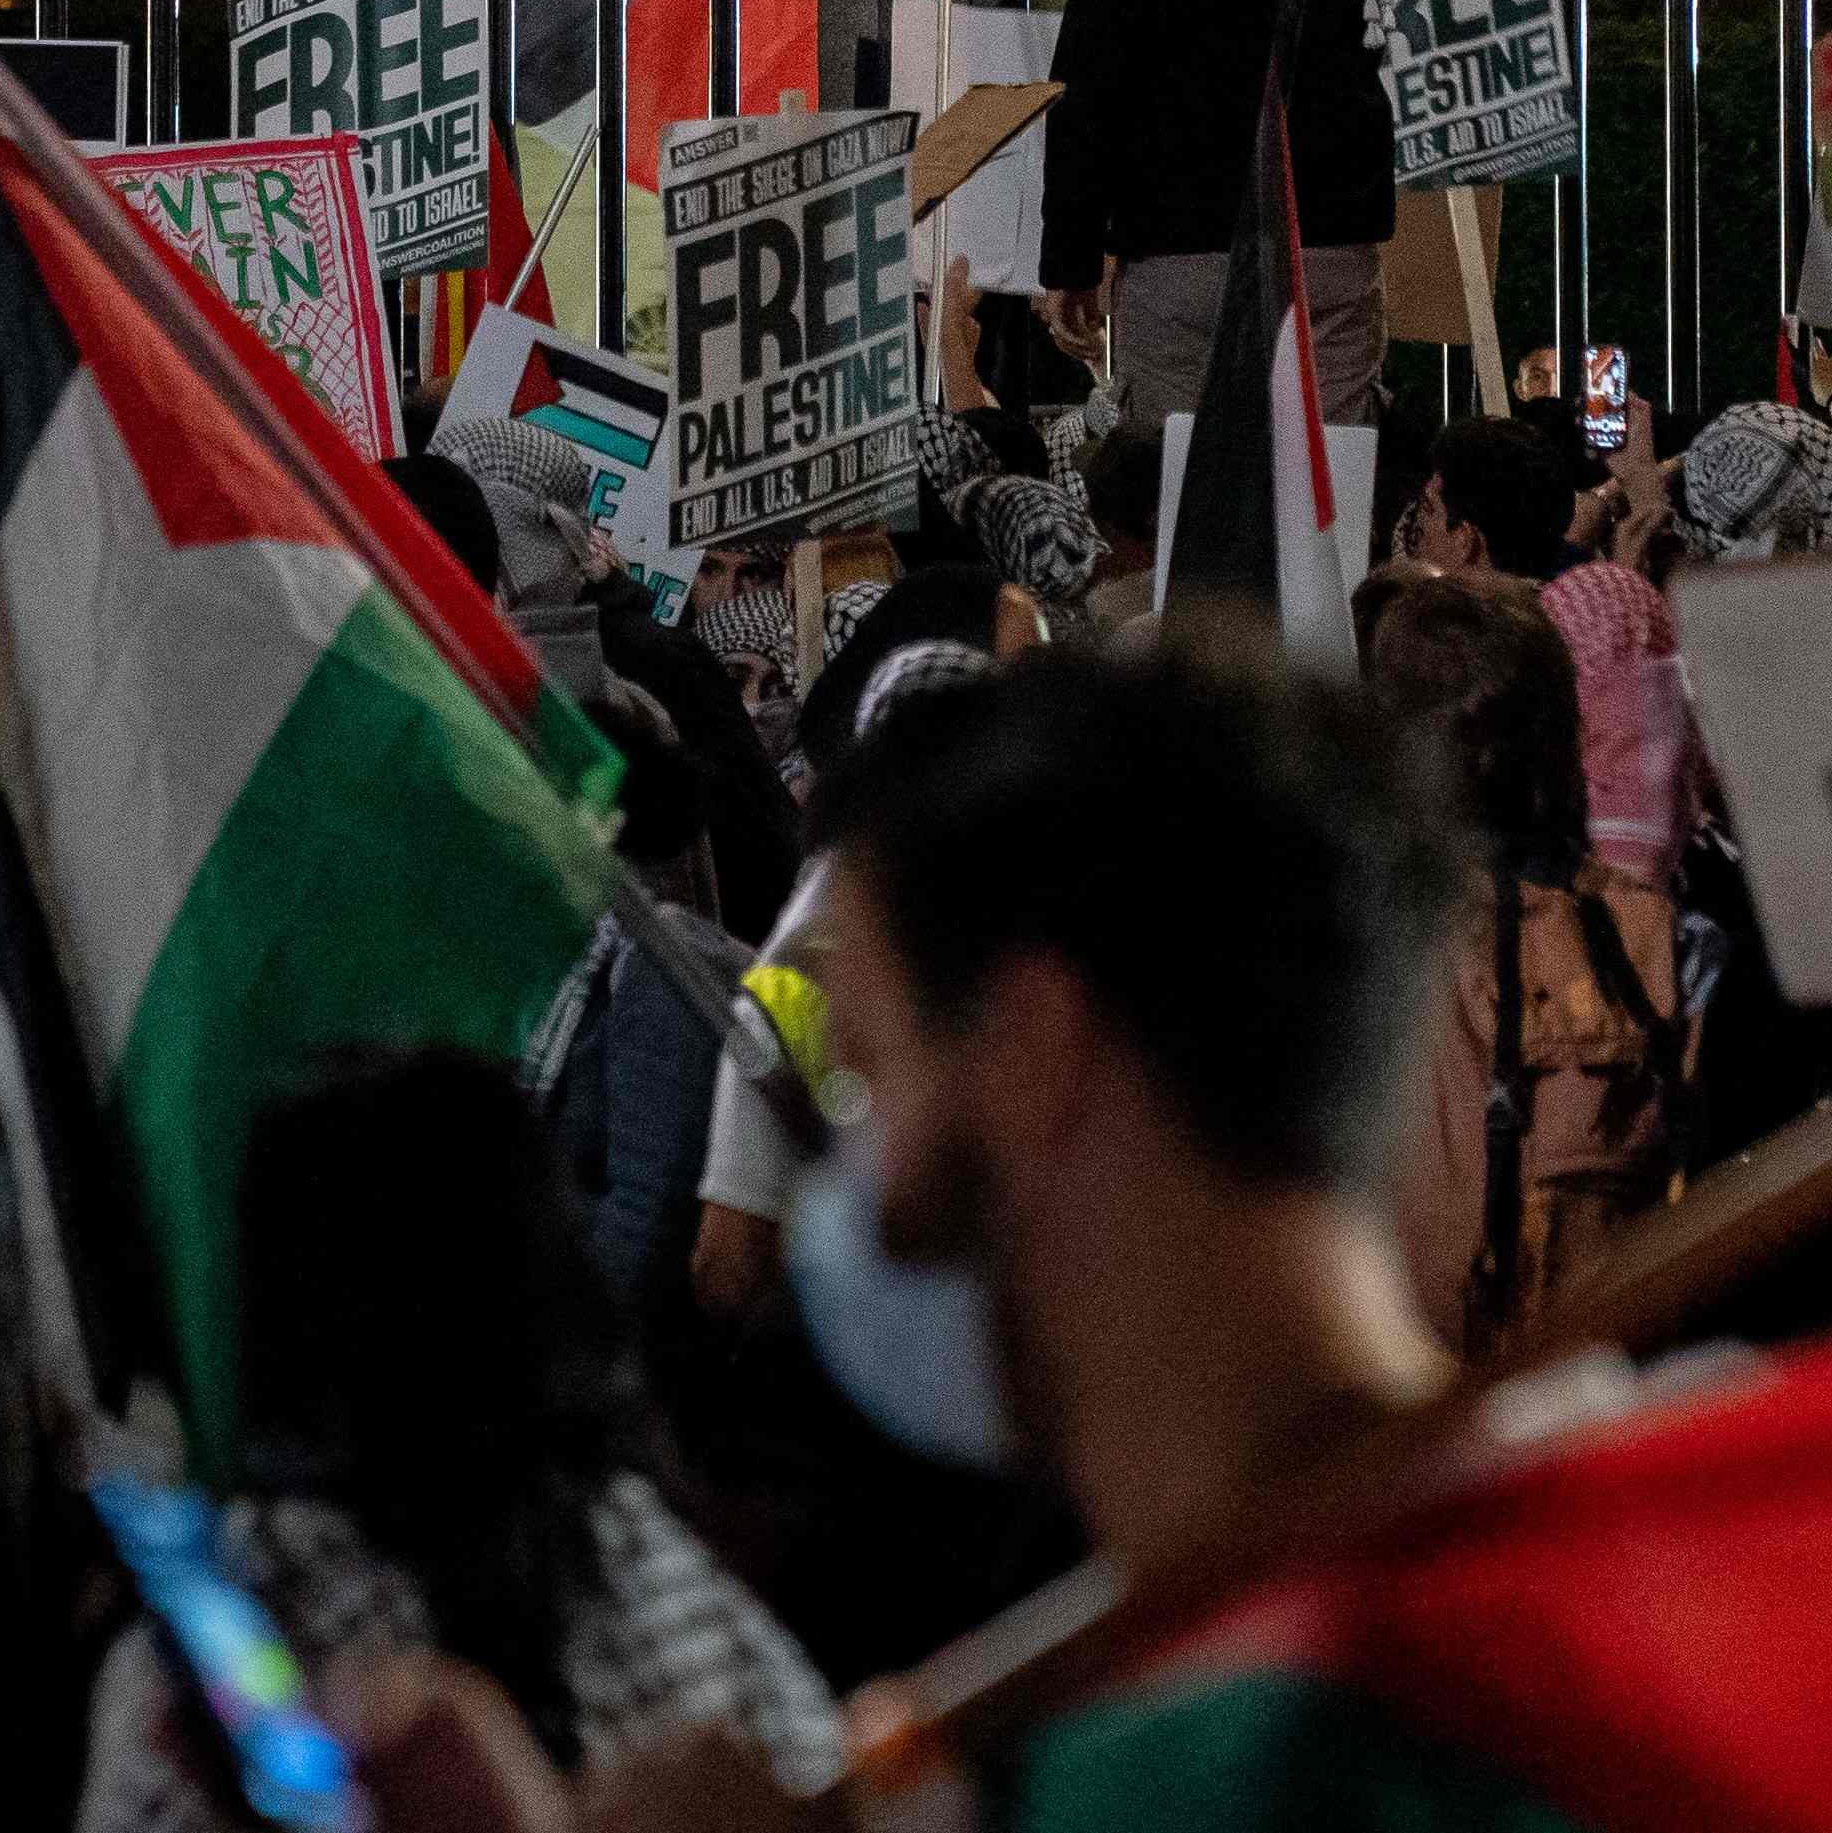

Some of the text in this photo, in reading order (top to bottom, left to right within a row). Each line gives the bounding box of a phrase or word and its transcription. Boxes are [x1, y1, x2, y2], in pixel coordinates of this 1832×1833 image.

[674, 129, 736, 166] ANSWER
[674, 117, 912, 231] END THE SIEGE ON GAZA NOW!
[395, 199, 418, 236] TO
[424, 179, 484, 227] ISRAEL
[676, 167, 907, 405] FREE
[681, 494, 717, 541] END
[723, 481, 757, 528] ALL
[763, 468, 803, 514] U.S.
[809, 455, 834, 499] AID
[839, 445, 858, 486] TO
[862, 424, 915, 477] ISRAEL
